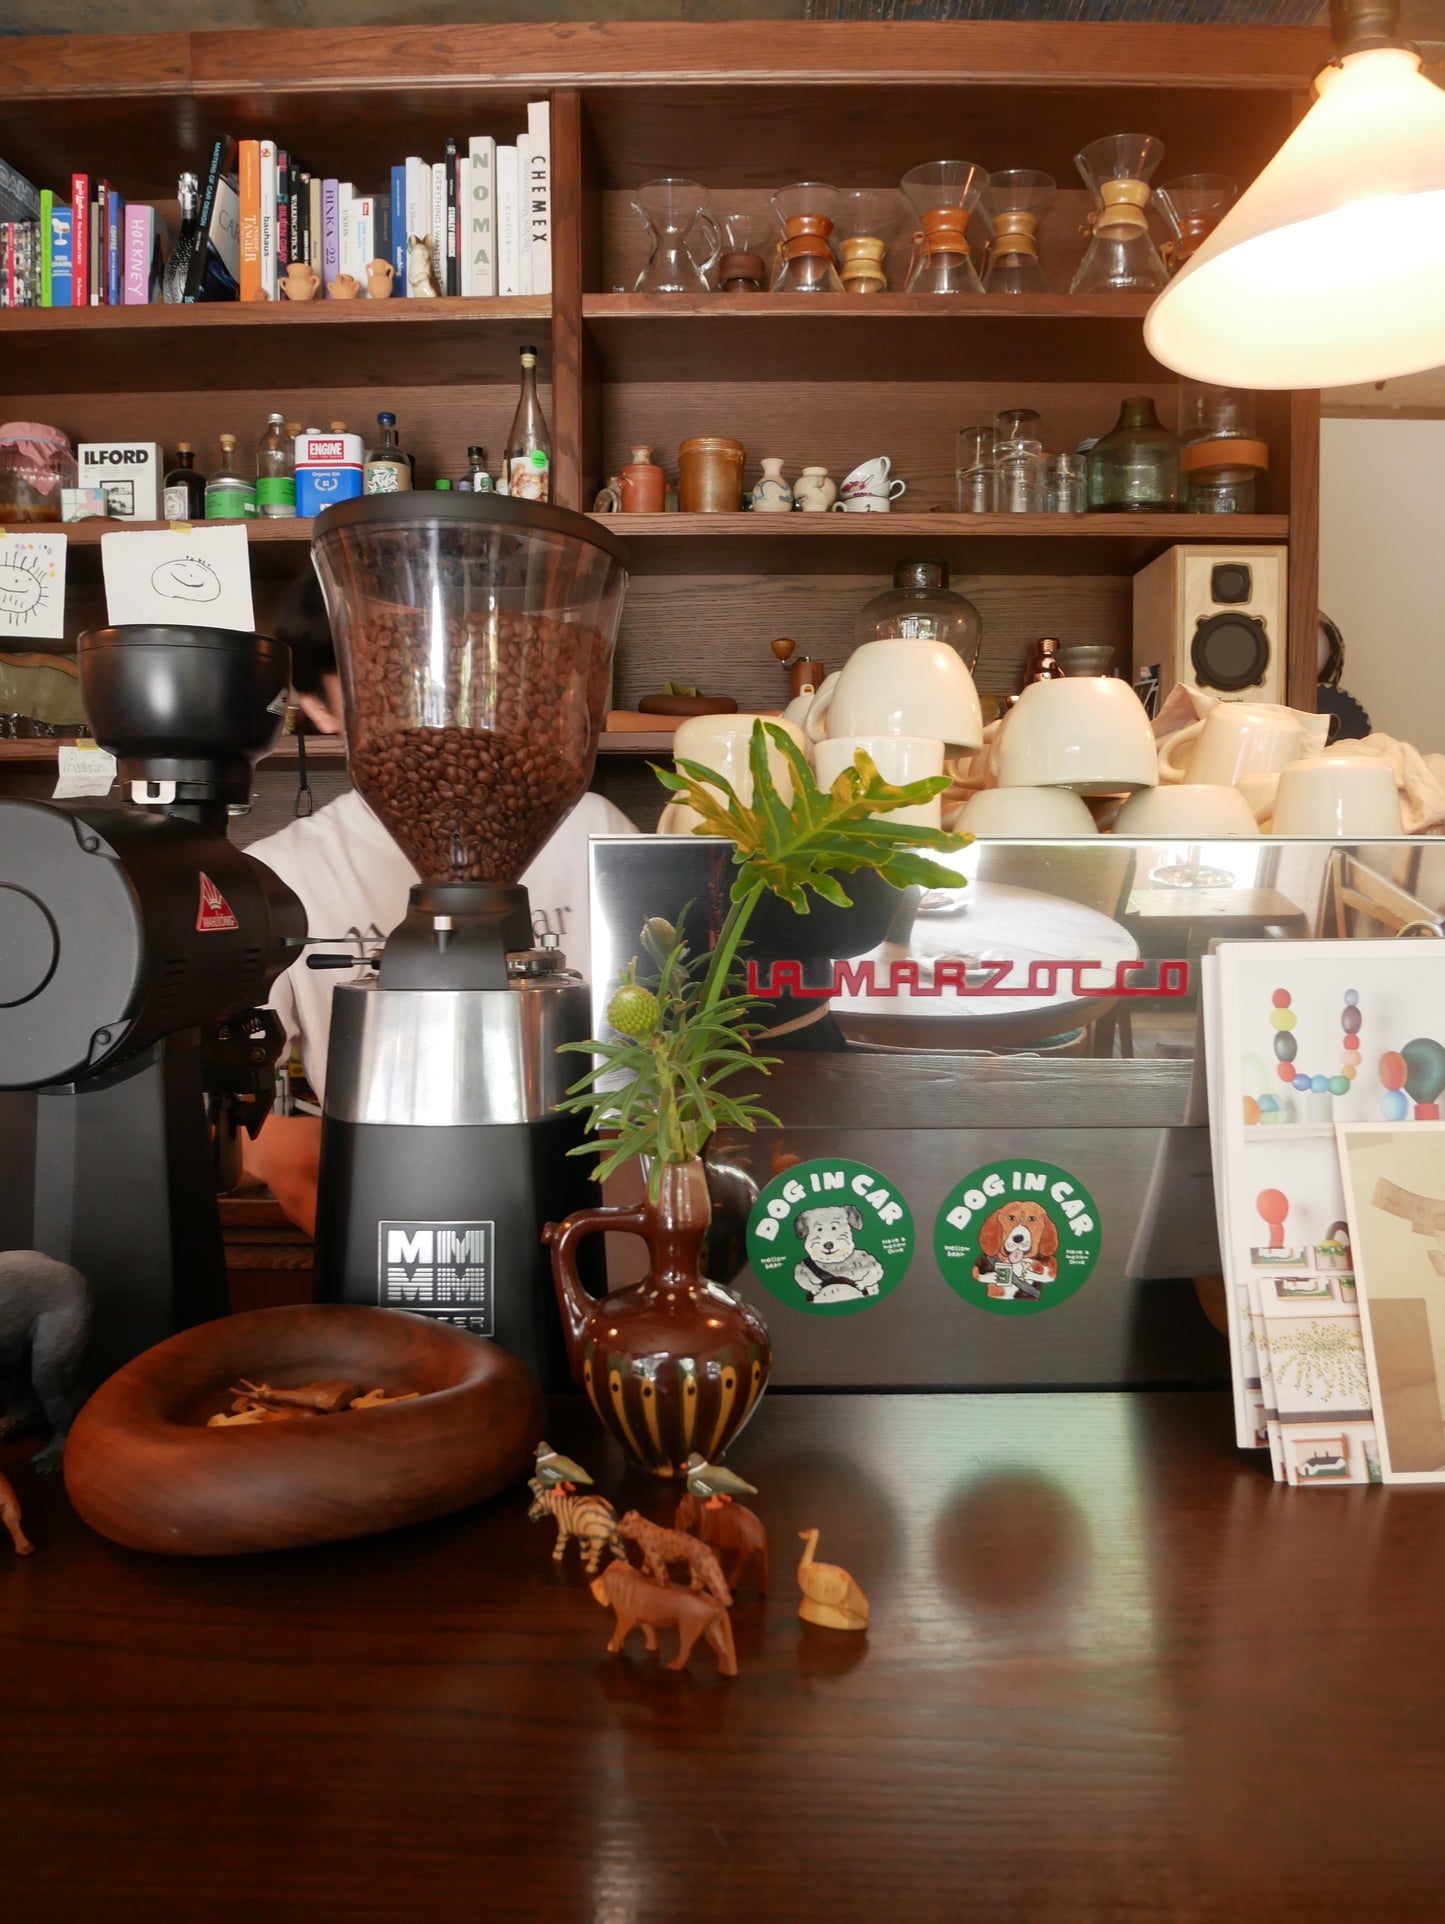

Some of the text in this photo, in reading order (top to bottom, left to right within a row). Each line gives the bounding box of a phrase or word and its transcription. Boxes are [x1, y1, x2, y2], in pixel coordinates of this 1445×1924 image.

[200, 141, 222, 228] MASTERS OF CAR DESIGN
[434, 170, 443, 224] EVERYTHING
[472, 153, 490, 265] NOMA
[531, 156, 547, 243] CHEMEX
[109, 225, 117, 251] COFFEE
[127, 219, 144, 297] HOCKNEY
[243, 214, 258, 263] TANGIER
[263, 216, 271, 257] bauhaus
[279, 205, 288, 264] EILEEN GRAY
[434, 230, 443, 258] WANT
[84, 449, 149, 465] ILFORD
[309, 442, 343, 456] ENGINE
[747, 960, 803, 997] LA
[755, 1171, 904, 1241] DOG IN CAR
[946, 1171, 1094, 1237] DOG IN CAR
